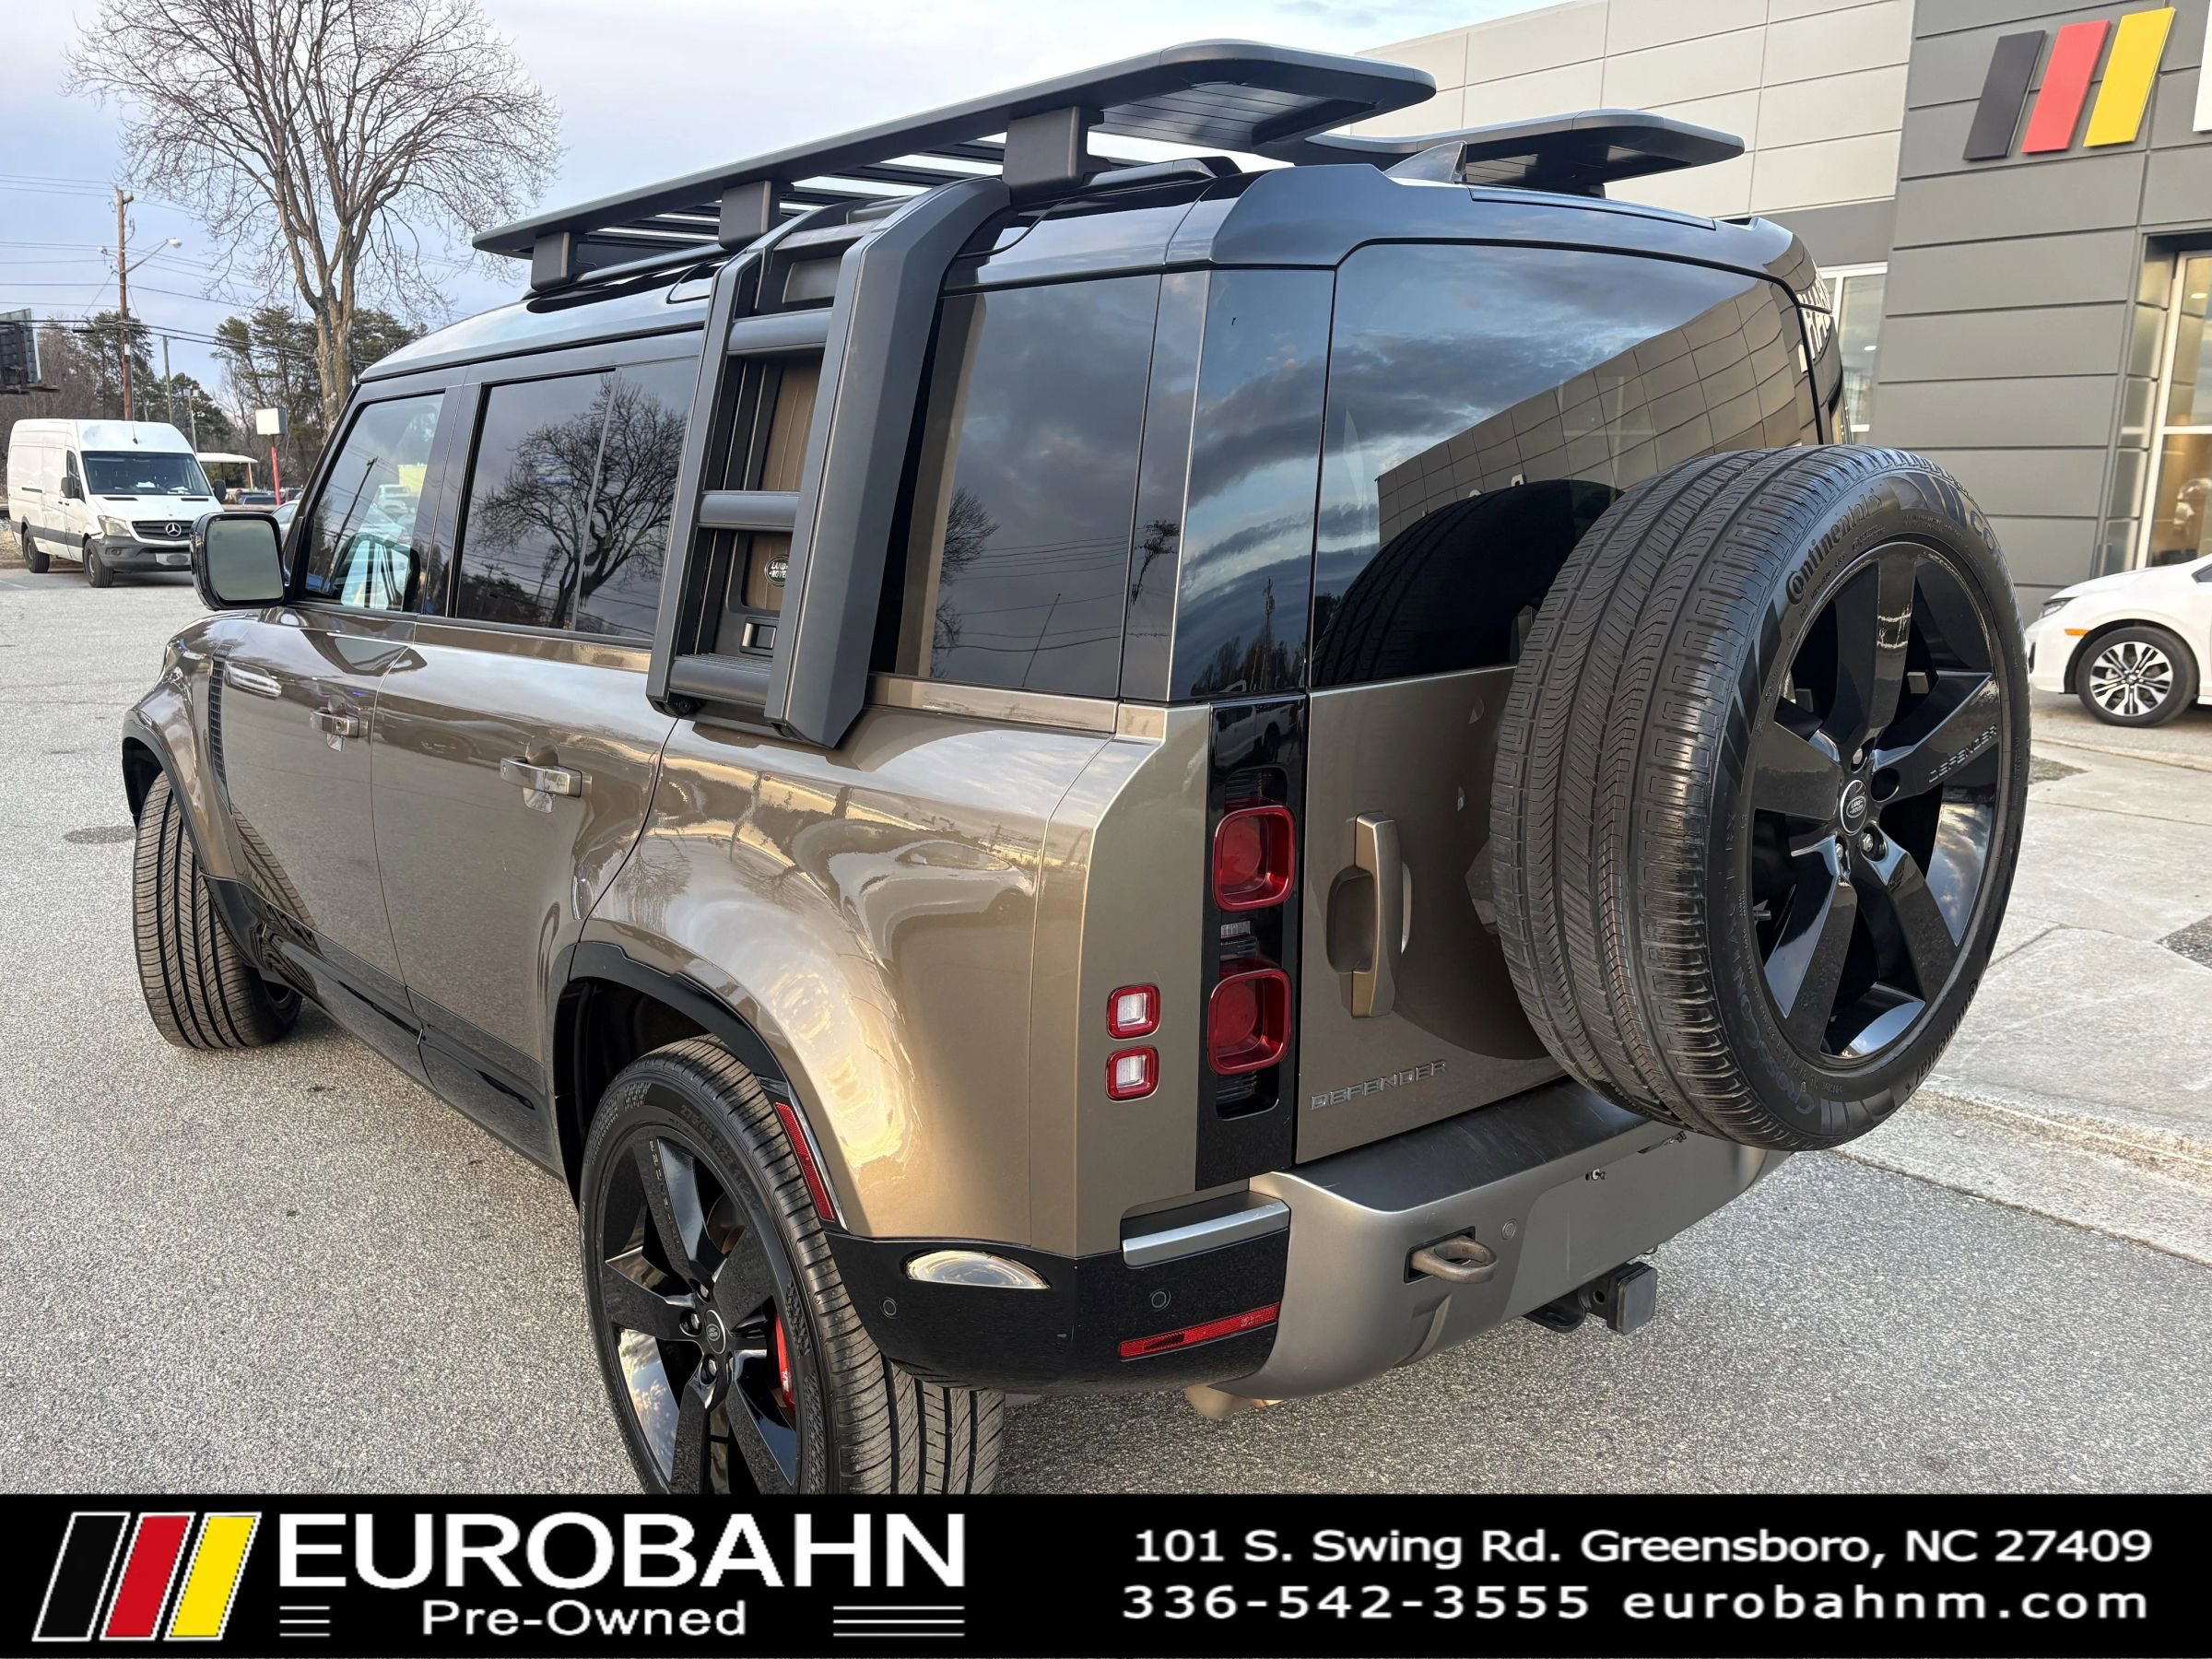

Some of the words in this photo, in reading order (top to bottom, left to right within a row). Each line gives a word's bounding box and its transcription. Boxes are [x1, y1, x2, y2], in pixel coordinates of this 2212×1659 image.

[771, 561, 787, 571] LAND
[771, 570, 787, 579] ROVE
[1786, 492, 1869, 606] Continental
[1929, 724, 1997, 782] DEFENDER
[1312, 1059, 1446, 1111] DEFENDER
